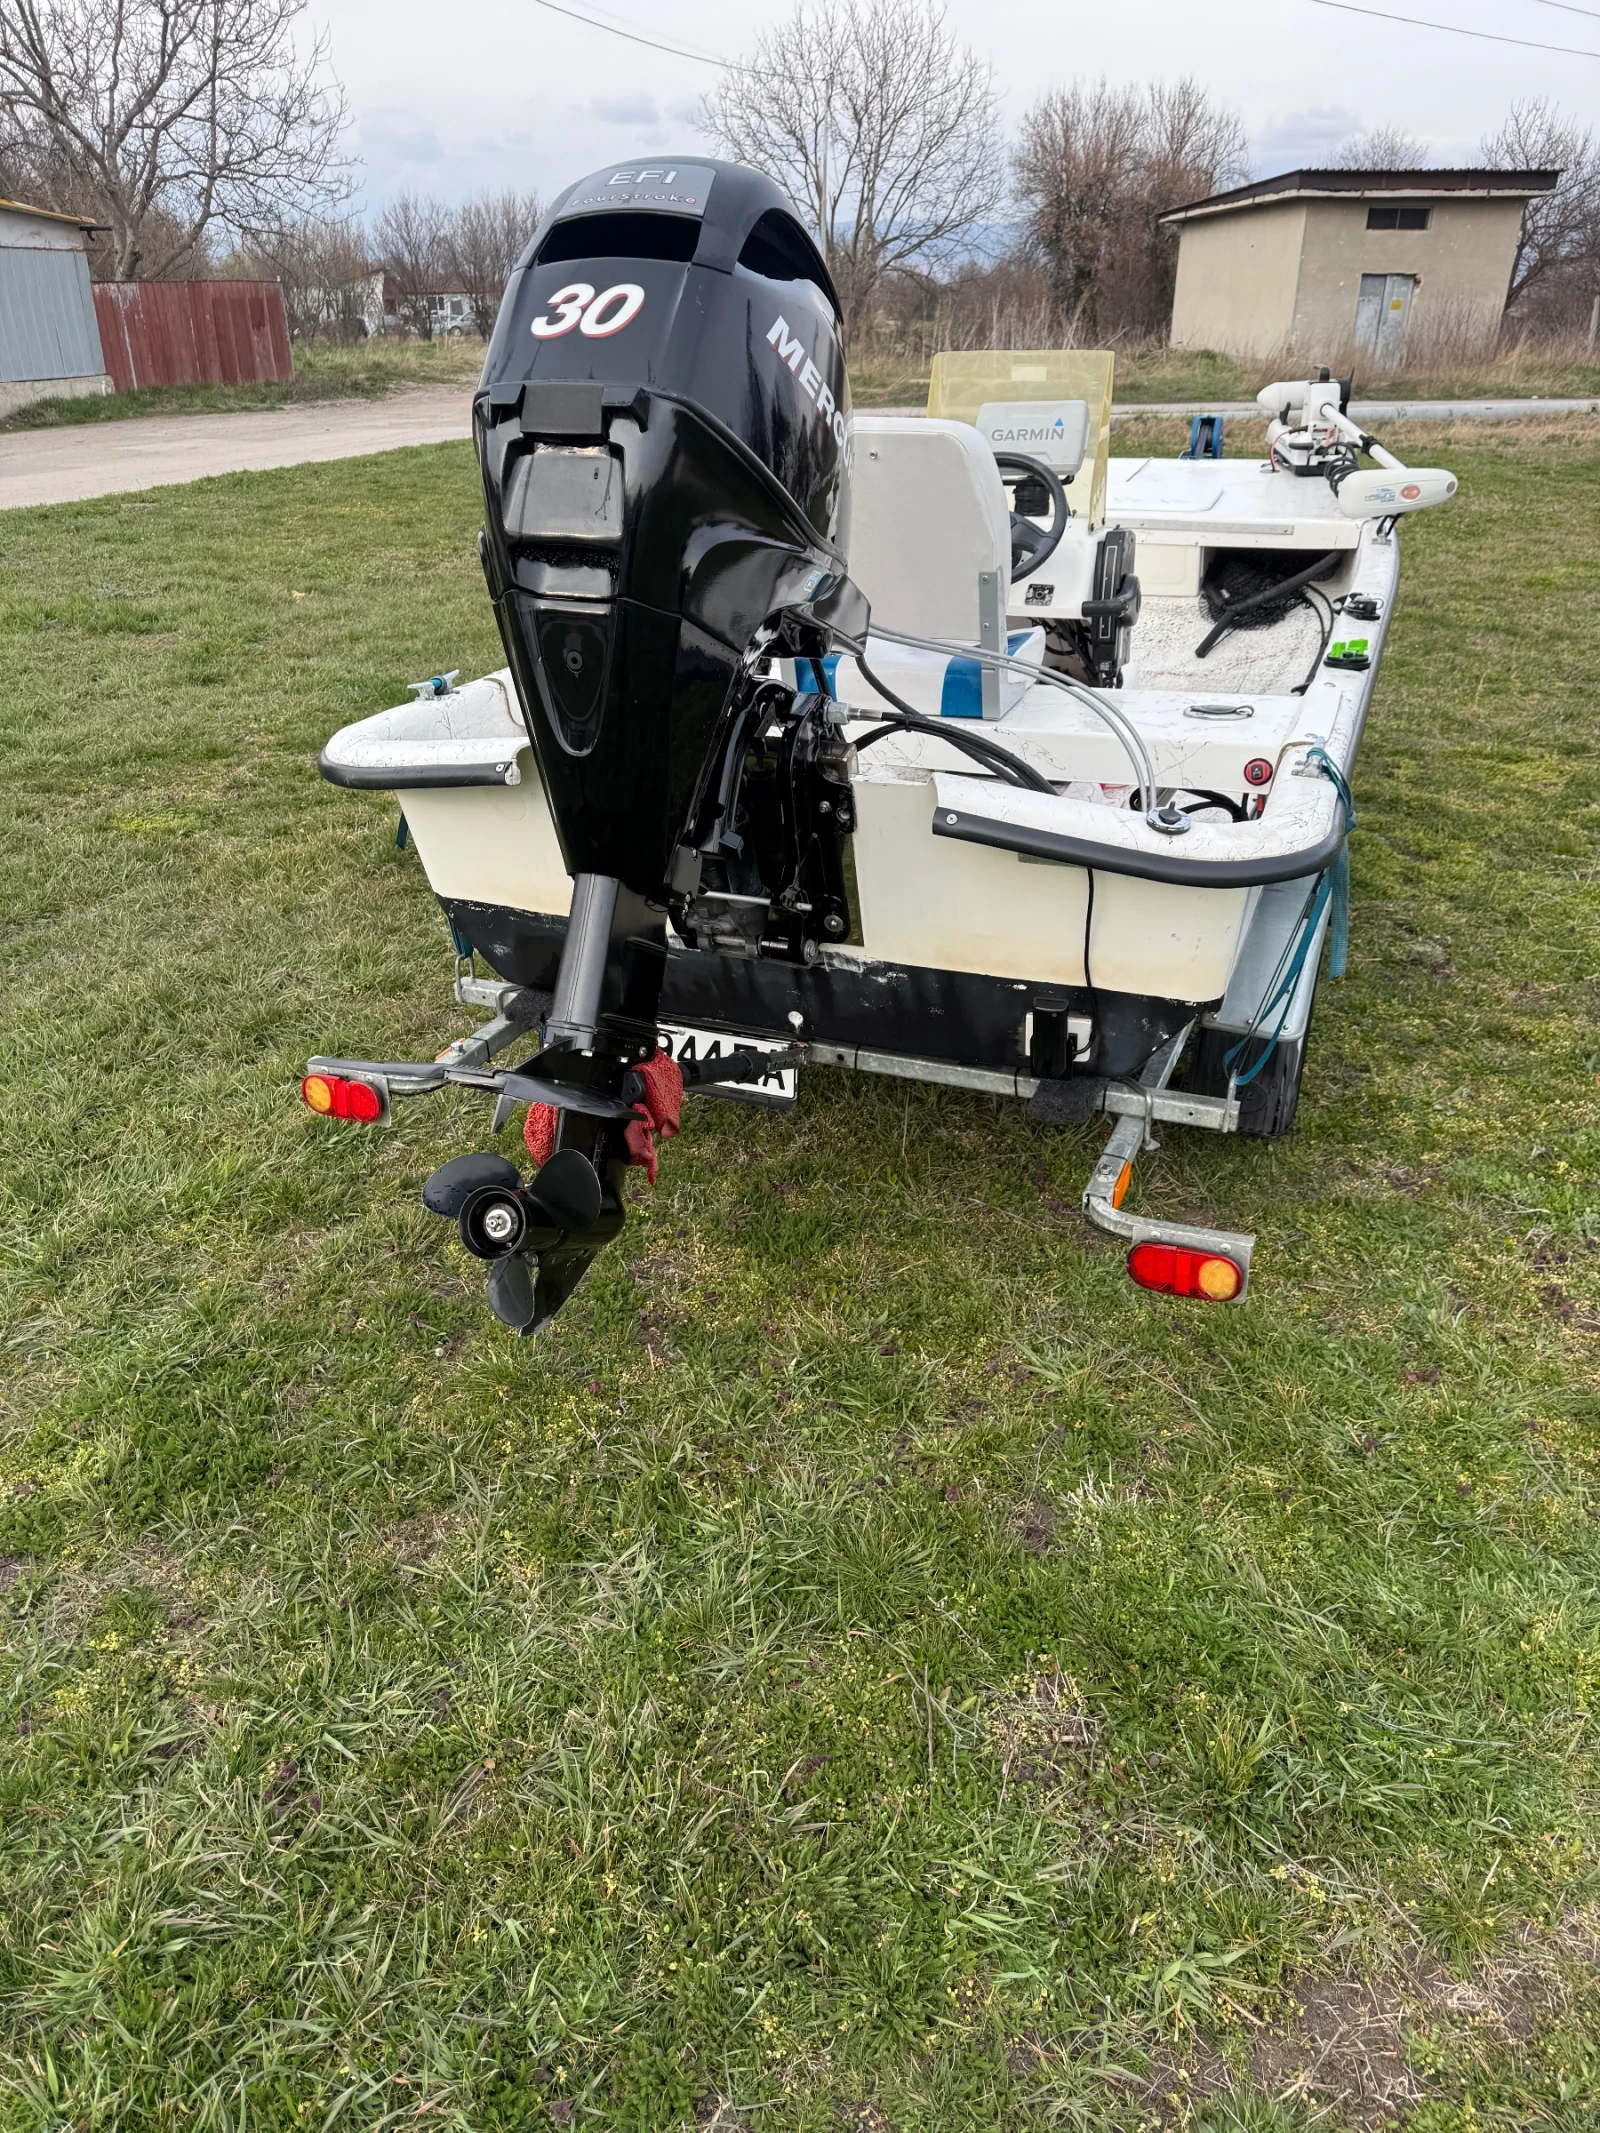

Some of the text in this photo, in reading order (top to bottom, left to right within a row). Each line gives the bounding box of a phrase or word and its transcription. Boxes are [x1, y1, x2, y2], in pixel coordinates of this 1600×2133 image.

[605, 170, 678, 186] EFI
[530, 283, 645, 339] 30
[991, 428, 1065, 442] GARMIN
